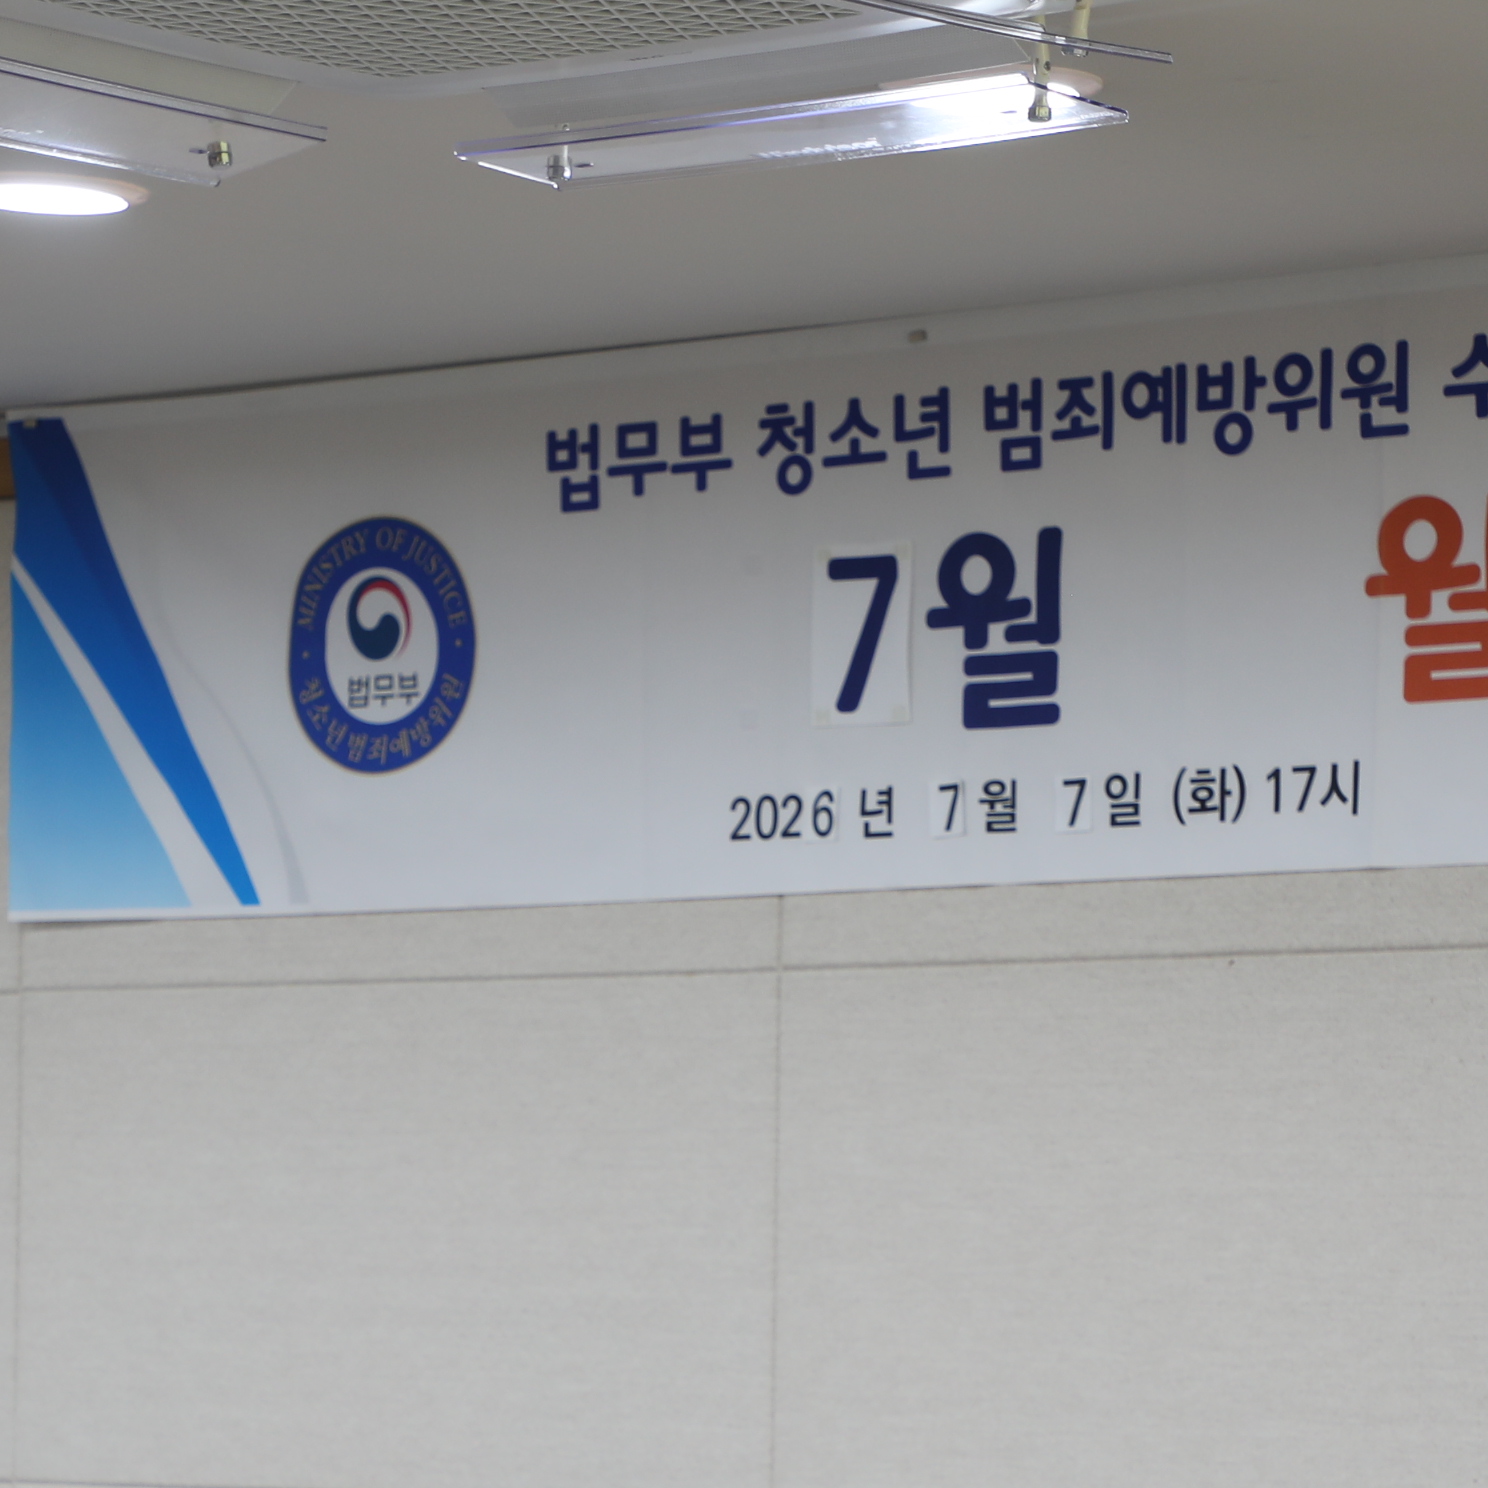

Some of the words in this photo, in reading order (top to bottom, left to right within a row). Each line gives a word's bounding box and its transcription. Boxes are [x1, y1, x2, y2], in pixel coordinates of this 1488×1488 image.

[544, 410, 734, 515] 법무부
[755, 384, 953, 497] 청소년
[981, 337, 1411, 474] 범죄예방위원
[297, 528, 369, 631] MINISTRY
[375, 526, 407, 551] OF
[401, 535, 466, 630] JUSTICE
[347, 672, 420, 709] 법무부
[1172, 764, 1247, 825] (화)
[1266, 759, 1361, 816] 17시
